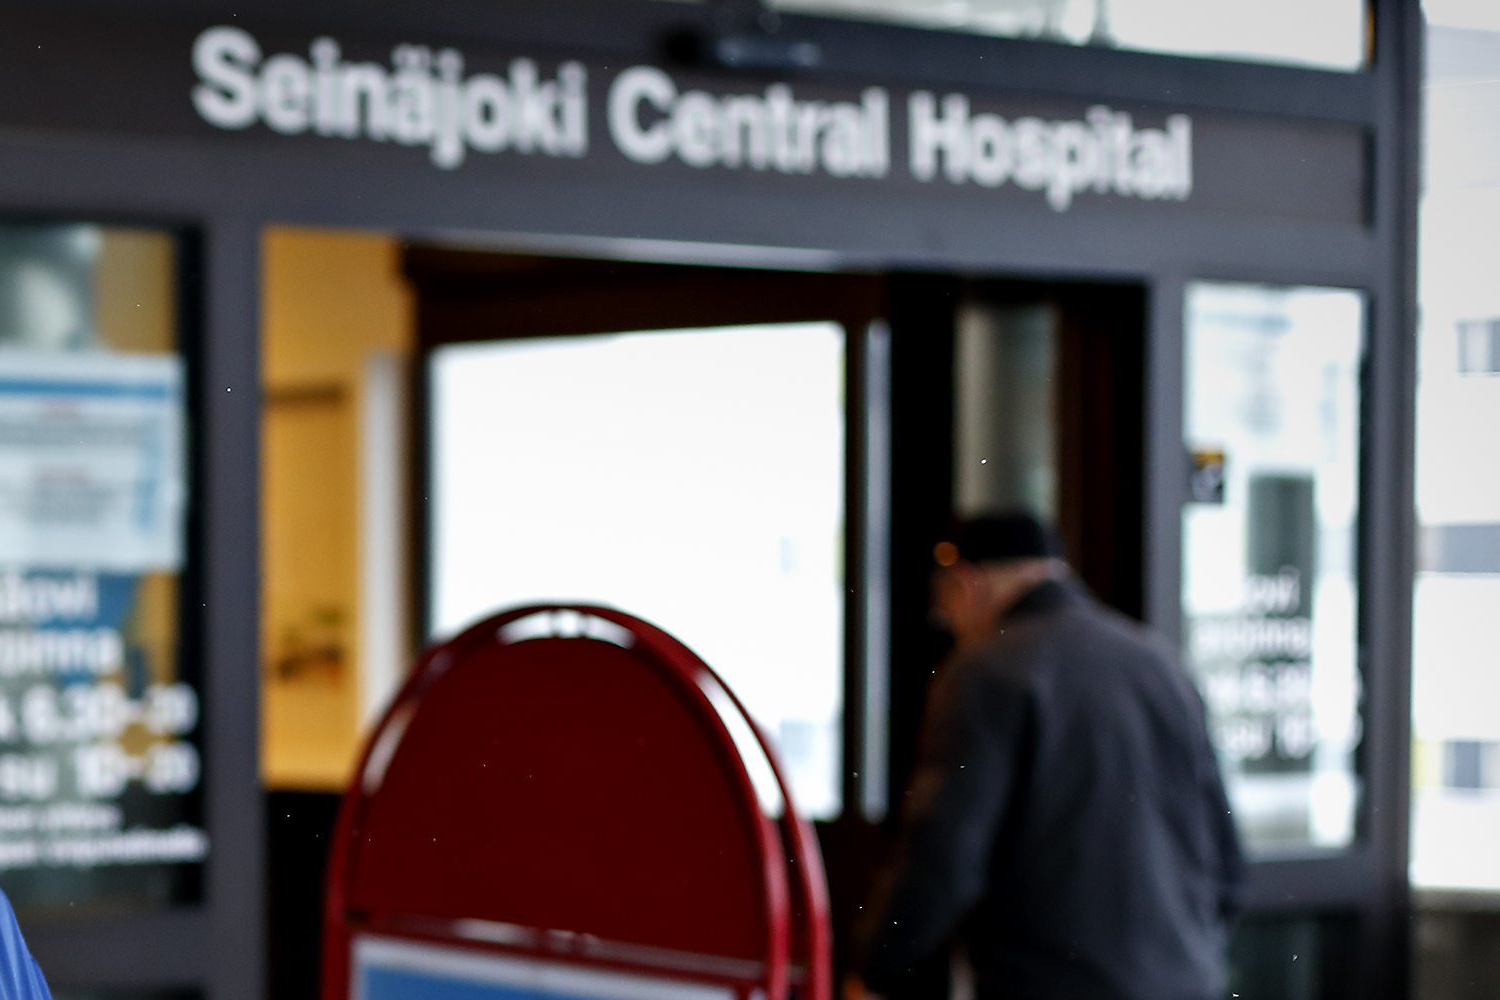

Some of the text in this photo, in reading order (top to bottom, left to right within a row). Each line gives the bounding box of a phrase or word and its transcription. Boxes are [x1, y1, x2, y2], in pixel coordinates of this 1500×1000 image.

[192, 26, 1192, 211] Seinäjoki Central Hospital
